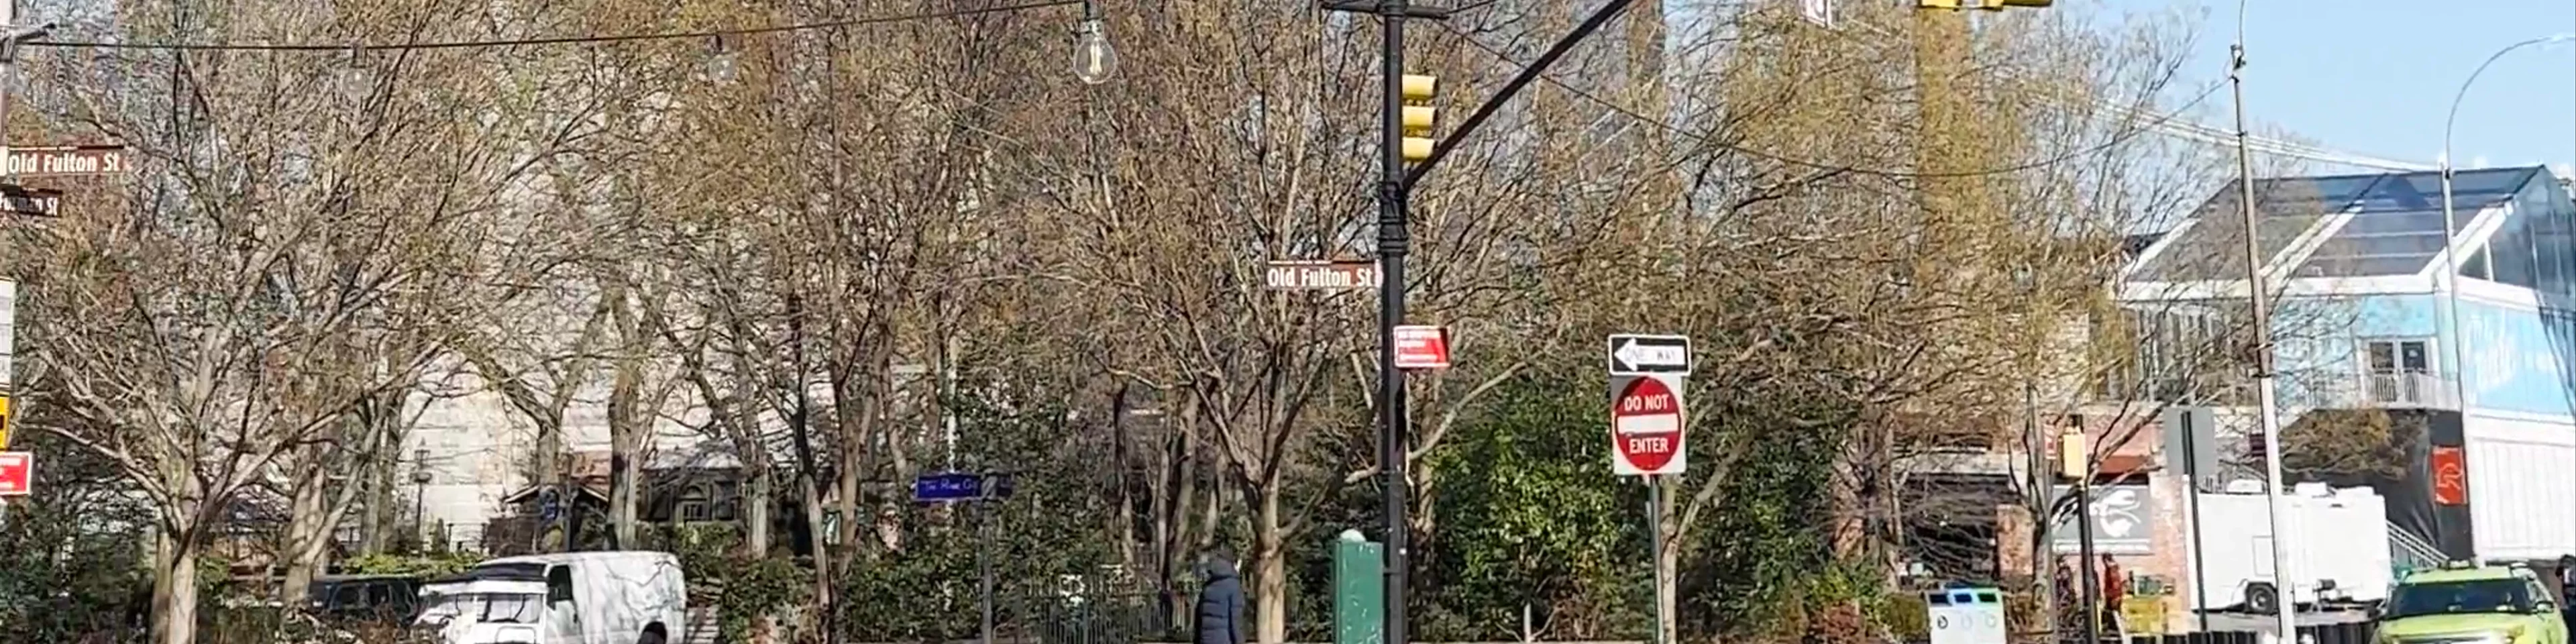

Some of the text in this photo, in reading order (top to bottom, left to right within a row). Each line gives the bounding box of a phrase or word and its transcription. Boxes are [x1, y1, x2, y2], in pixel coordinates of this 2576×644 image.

[9, 152, 119, 173] Old Fulton St
[46, 197, 58, 215] St
[1267, 267, 1373, 287] Old Fulton St
[1625, 347, 1648, 362] ONE
[1624, 394, 1669, 411] DO NOT
[1629, 438, 1669, 453] ENTER
